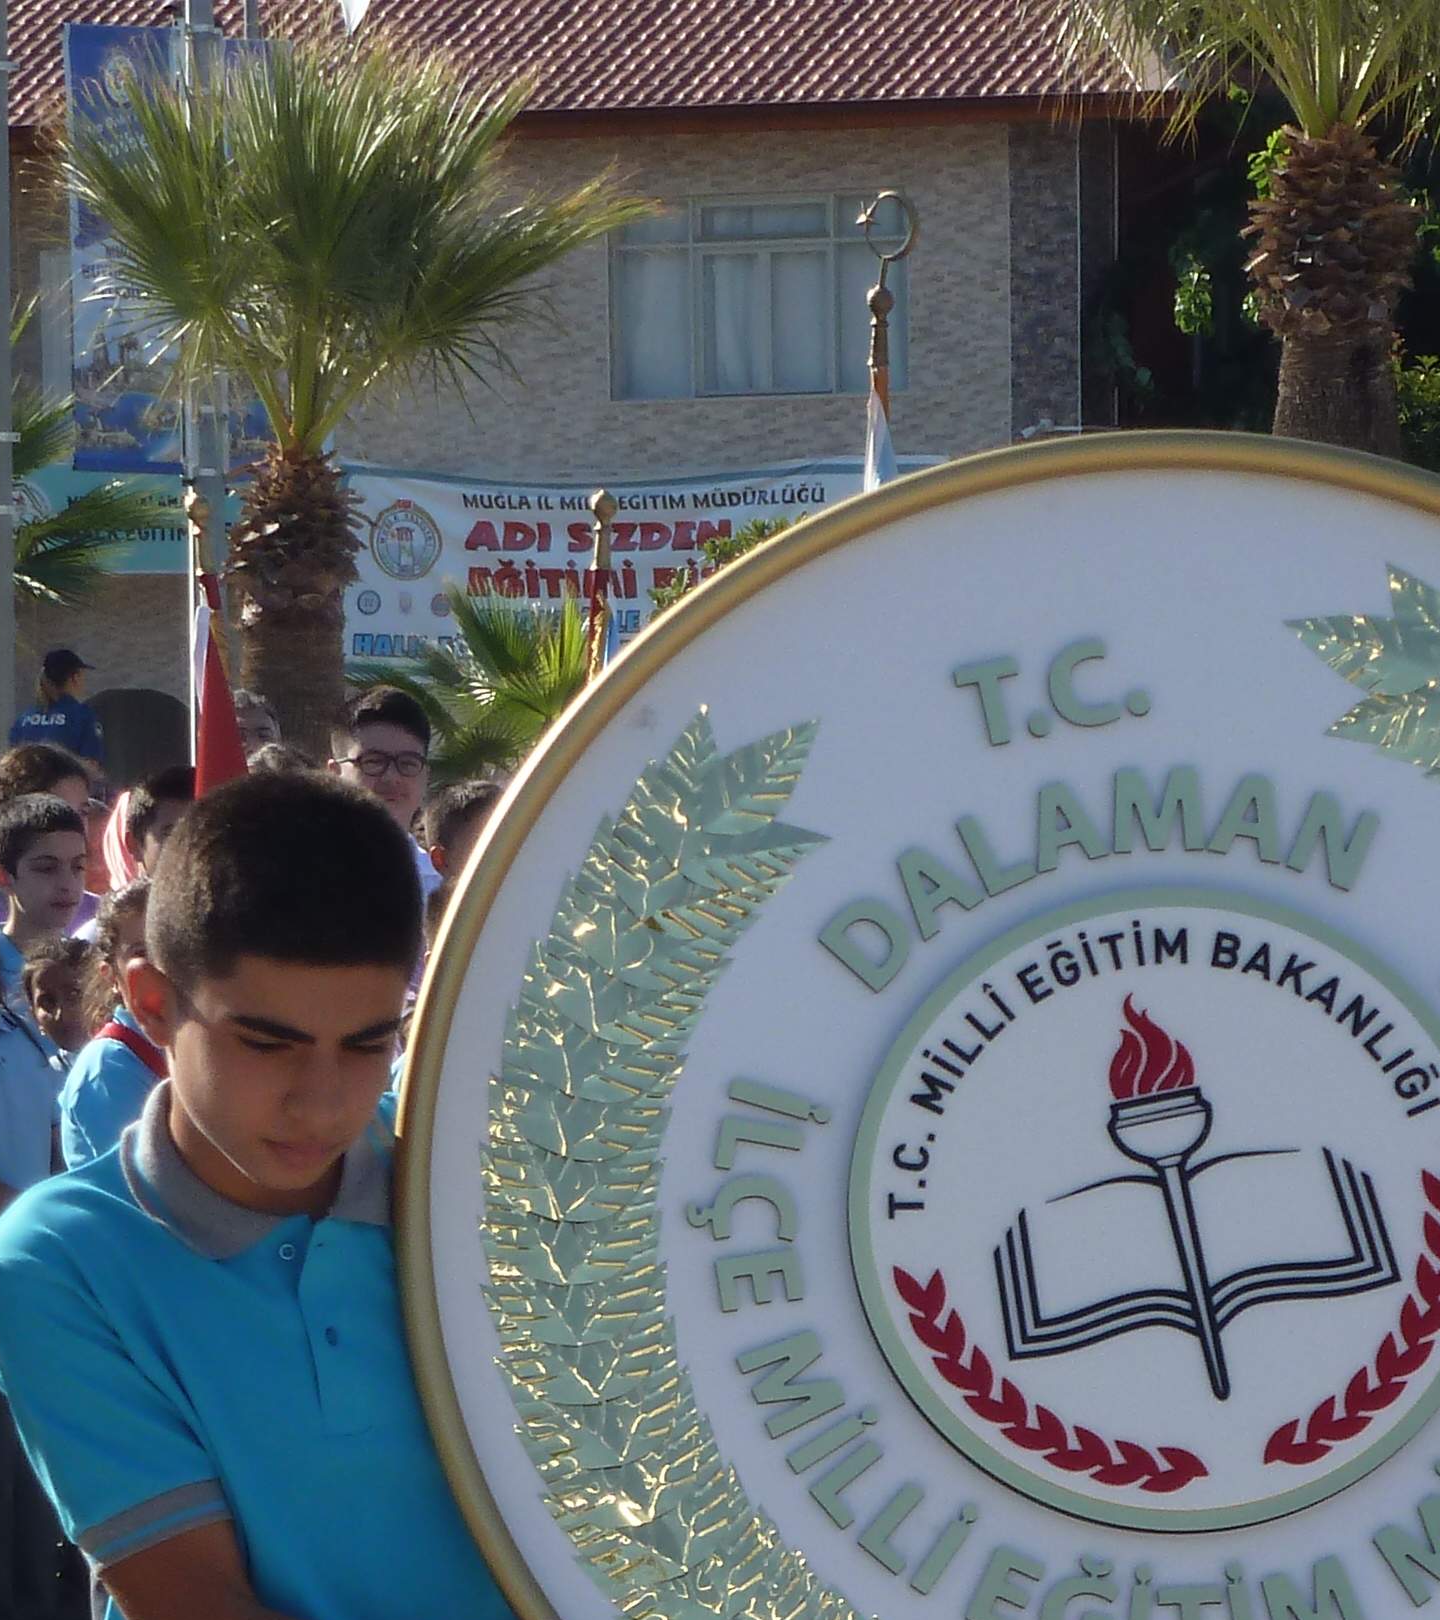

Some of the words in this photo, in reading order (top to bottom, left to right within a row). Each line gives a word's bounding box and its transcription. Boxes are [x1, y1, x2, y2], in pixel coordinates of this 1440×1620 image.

[464, 520, 552, 553] ADI
[566, 518, 732, 553] SZDEN
[692, 481, 826, 509] MÜDÜRLÜĞÜ
[952, 636, 1152, 747] T.C.
[817, 763, 1381, 994] DALAMAN
[887, 1131, 937, 1221] T.C.
[1015, 919, 1190, 1005] EĞİTİM
[686, 1078, 831, 1313] İLÇE
[734, 1330, 979, 1597] MİLLİ
